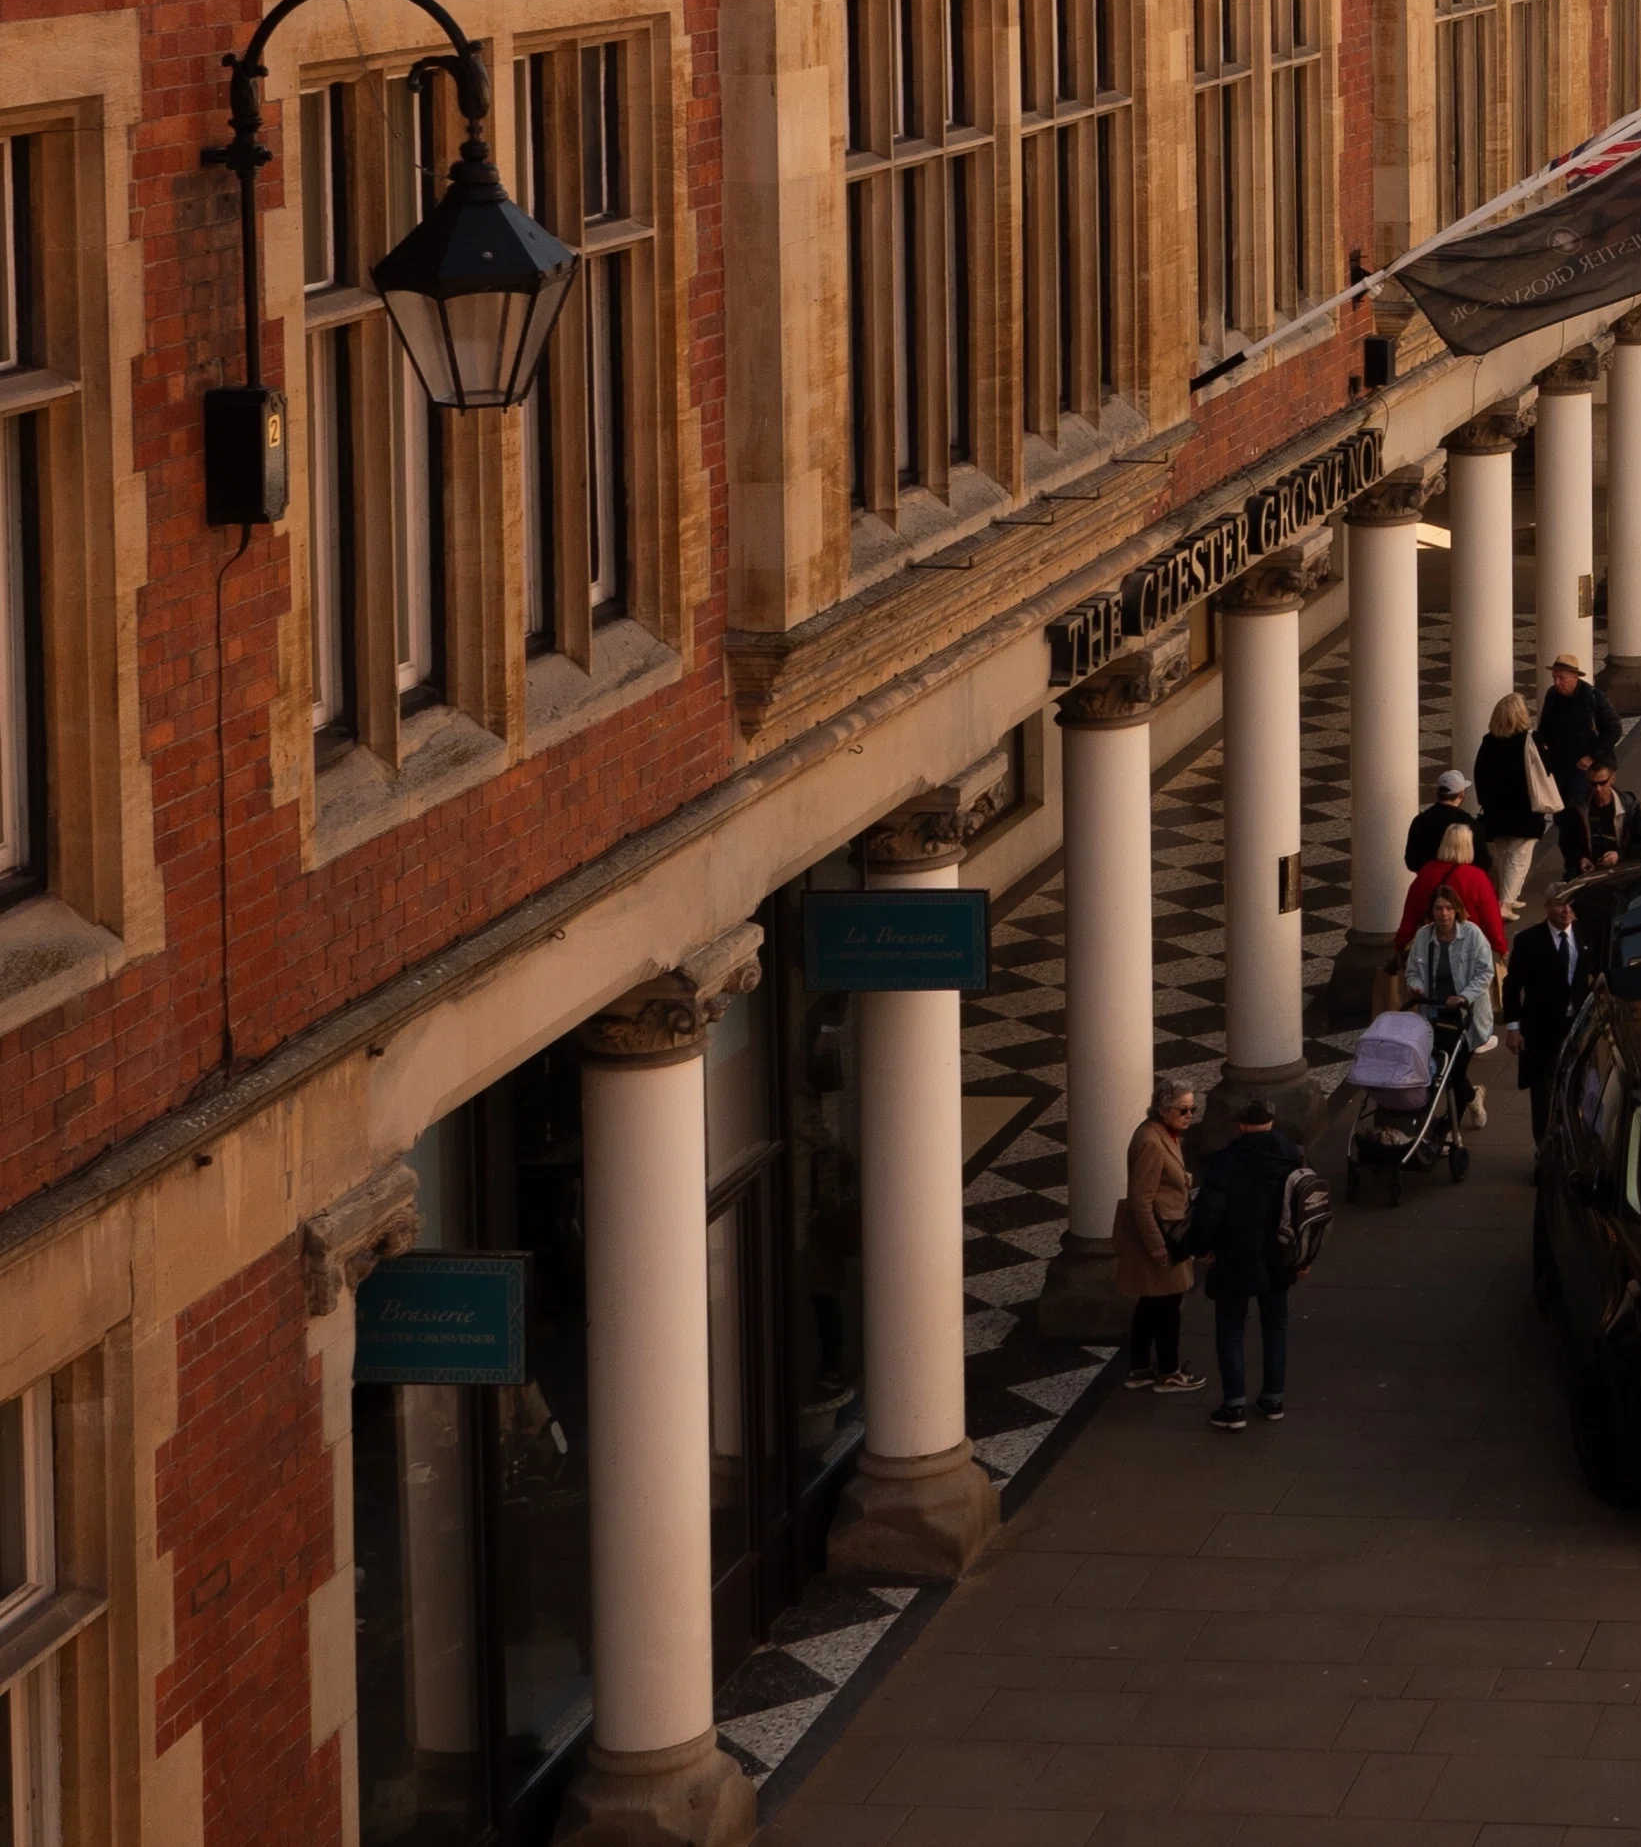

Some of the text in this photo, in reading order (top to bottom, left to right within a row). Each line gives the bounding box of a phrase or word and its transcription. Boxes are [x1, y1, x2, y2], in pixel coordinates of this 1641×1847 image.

[1051, 428, 1386, 688] THE CHESTER GROSVENOR
[379, 1299, 477, 1324] Brasserie
